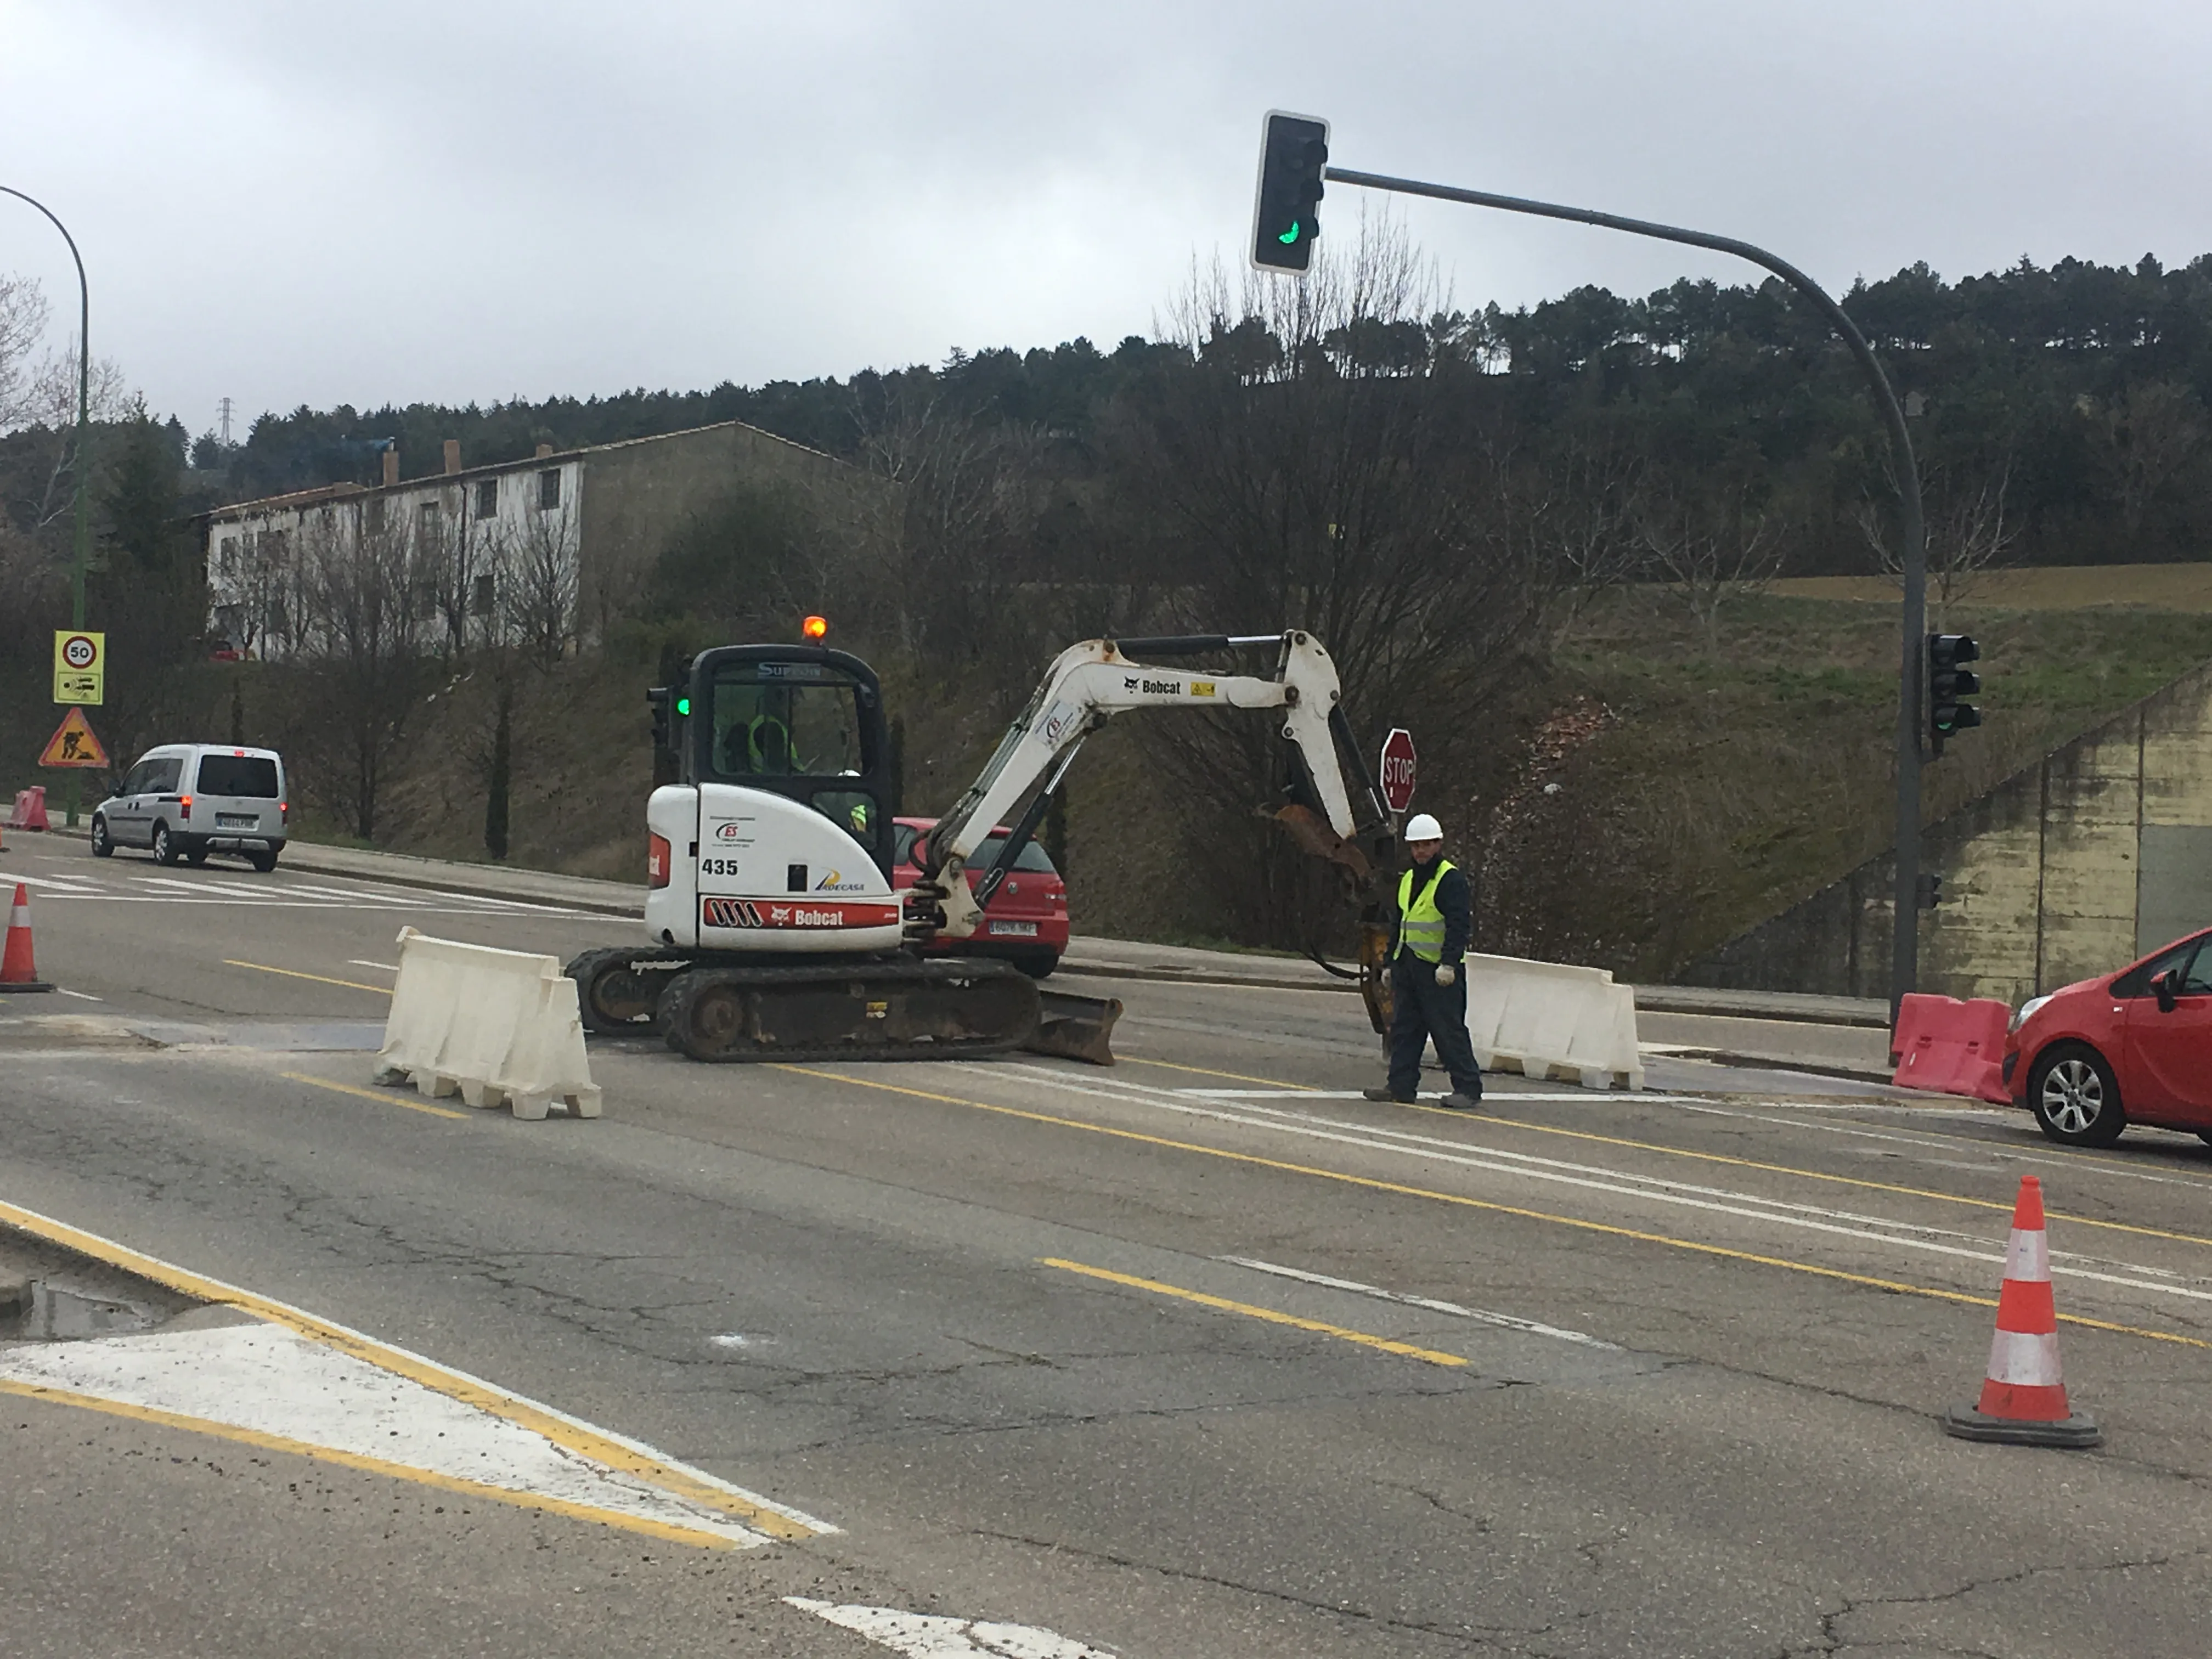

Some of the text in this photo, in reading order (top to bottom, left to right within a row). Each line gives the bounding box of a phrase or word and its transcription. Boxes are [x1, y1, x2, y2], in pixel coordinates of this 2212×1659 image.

[71, 647, 89, 658] 50
[1143, 680, 1181, 695] Bobcat
[1385, 757, 1414, 785] STOP
[702, 859, 738, 876] 435
[795, 909, 843, 926] Bobcat
